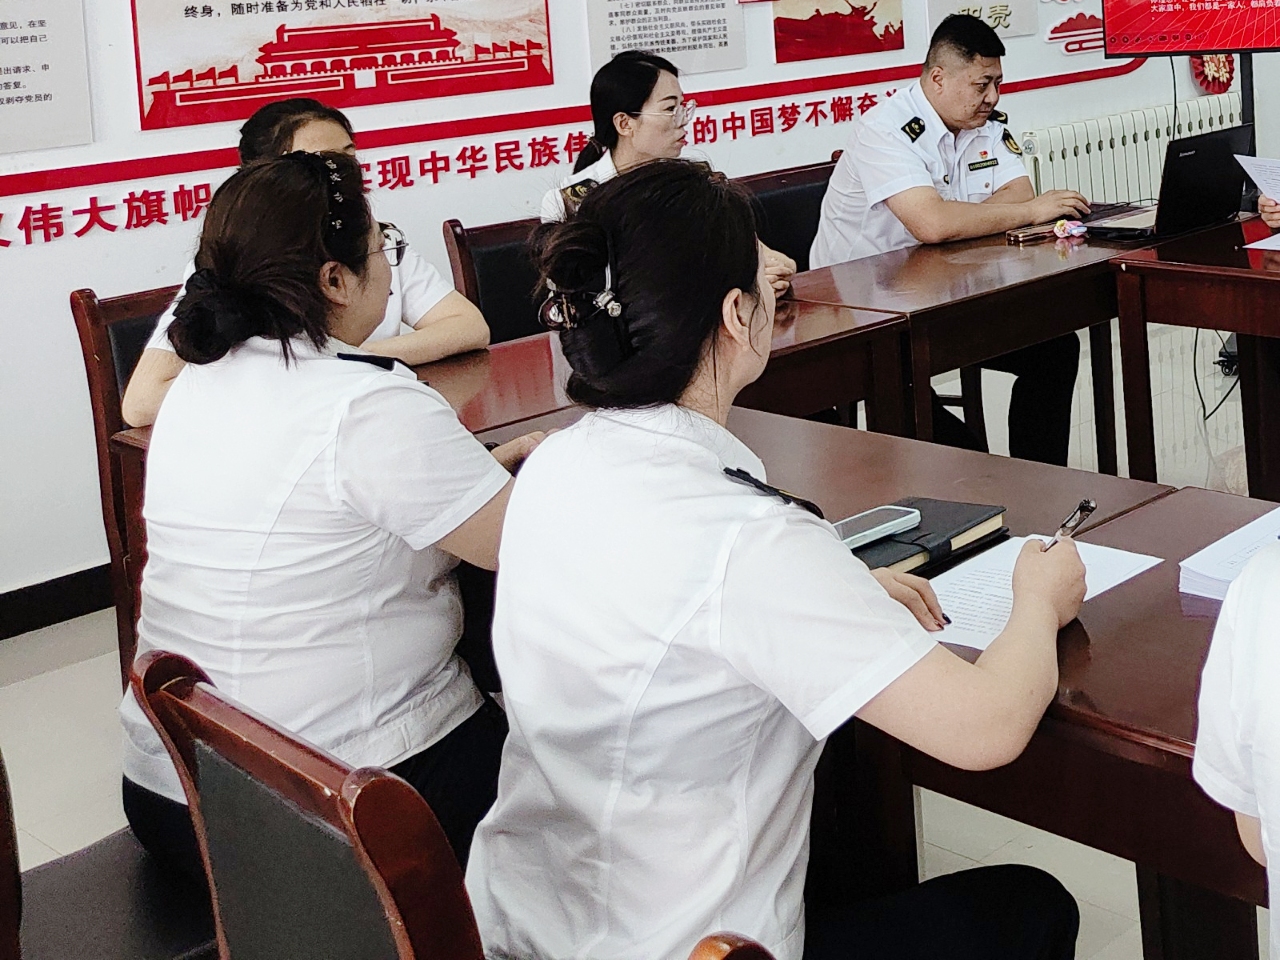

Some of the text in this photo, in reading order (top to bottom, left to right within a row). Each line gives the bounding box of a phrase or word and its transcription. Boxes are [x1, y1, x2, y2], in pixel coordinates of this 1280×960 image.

[0, 64, 50, 75] 出请求、申
[693, 89, 898, 146] 的中国梦不懈奋
